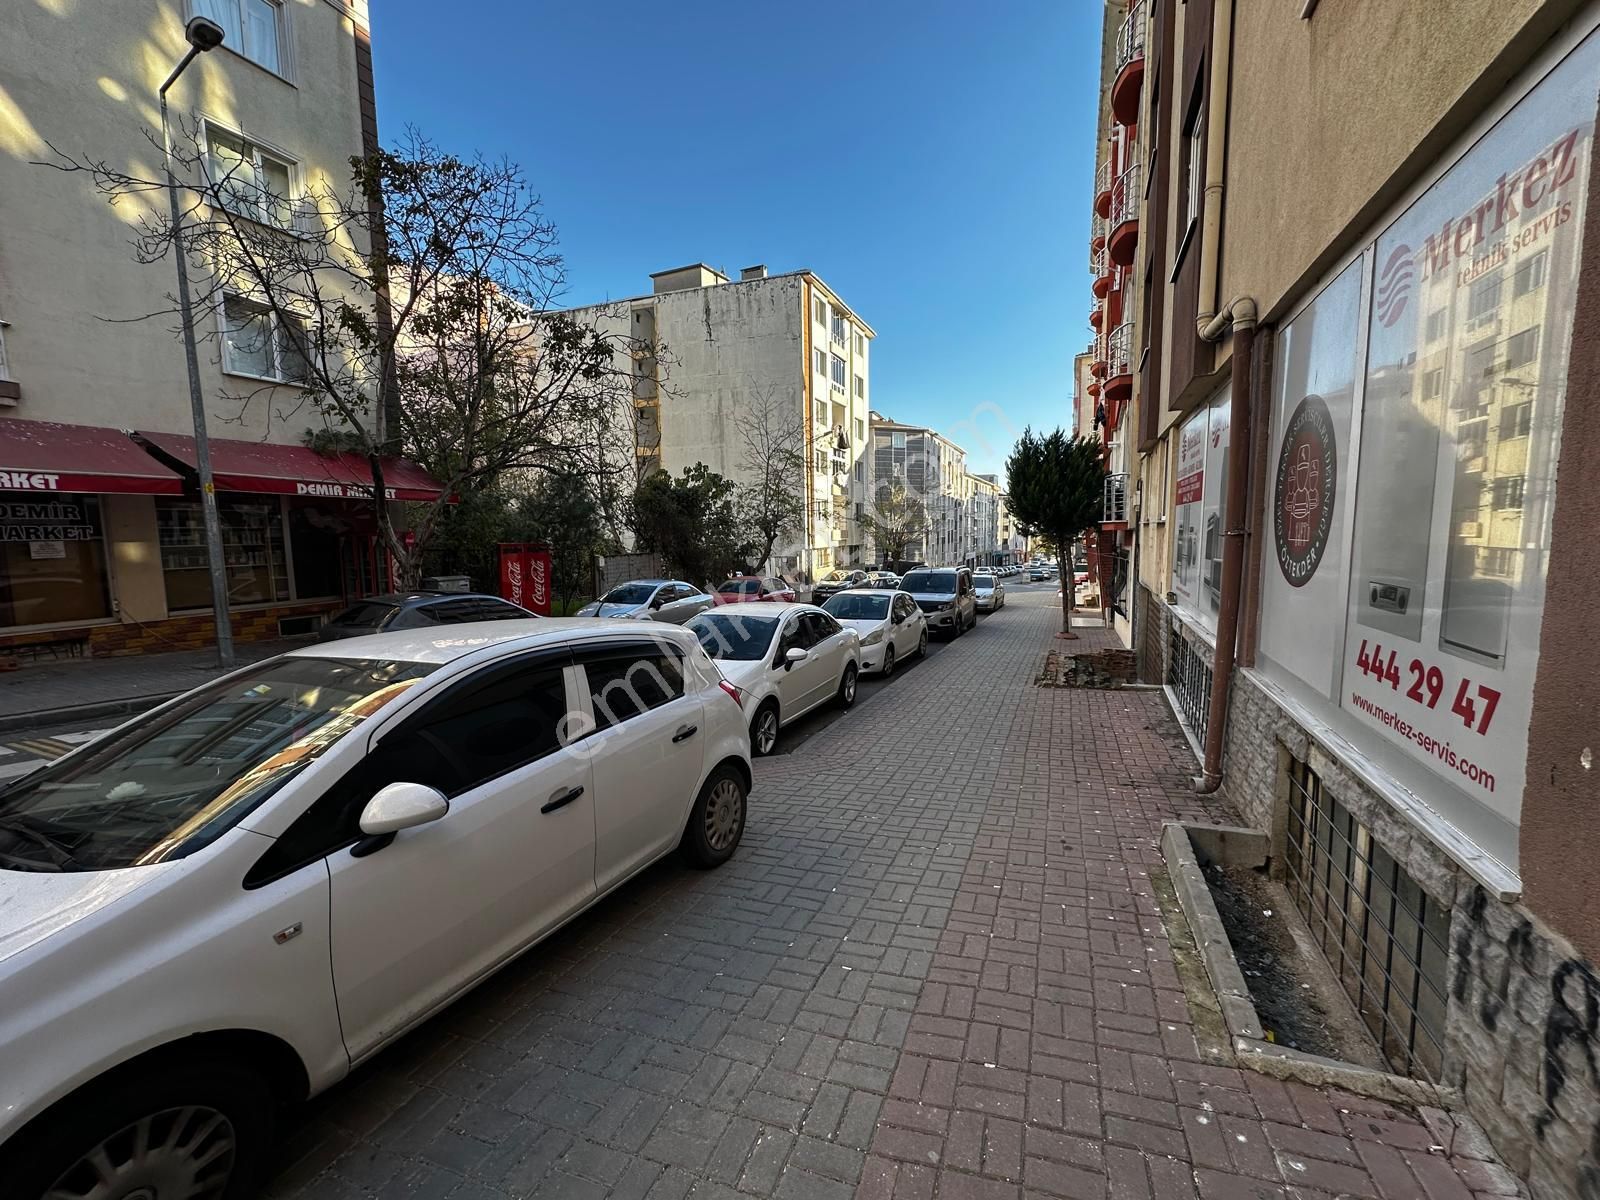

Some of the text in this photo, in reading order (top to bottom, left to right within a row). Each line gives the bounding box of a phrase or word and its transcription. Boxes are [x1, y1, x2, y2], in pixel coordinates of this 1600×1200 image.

[1421, 128, 1579, 283] Merkez
[1457, 200, 1572, 288] teknik servis
[0, 525, 93, 541] ARKET
[1356, 639, 1502, 736] 444 29 47
[1352, 692, 1495, 792] www.merkez-servis.com
